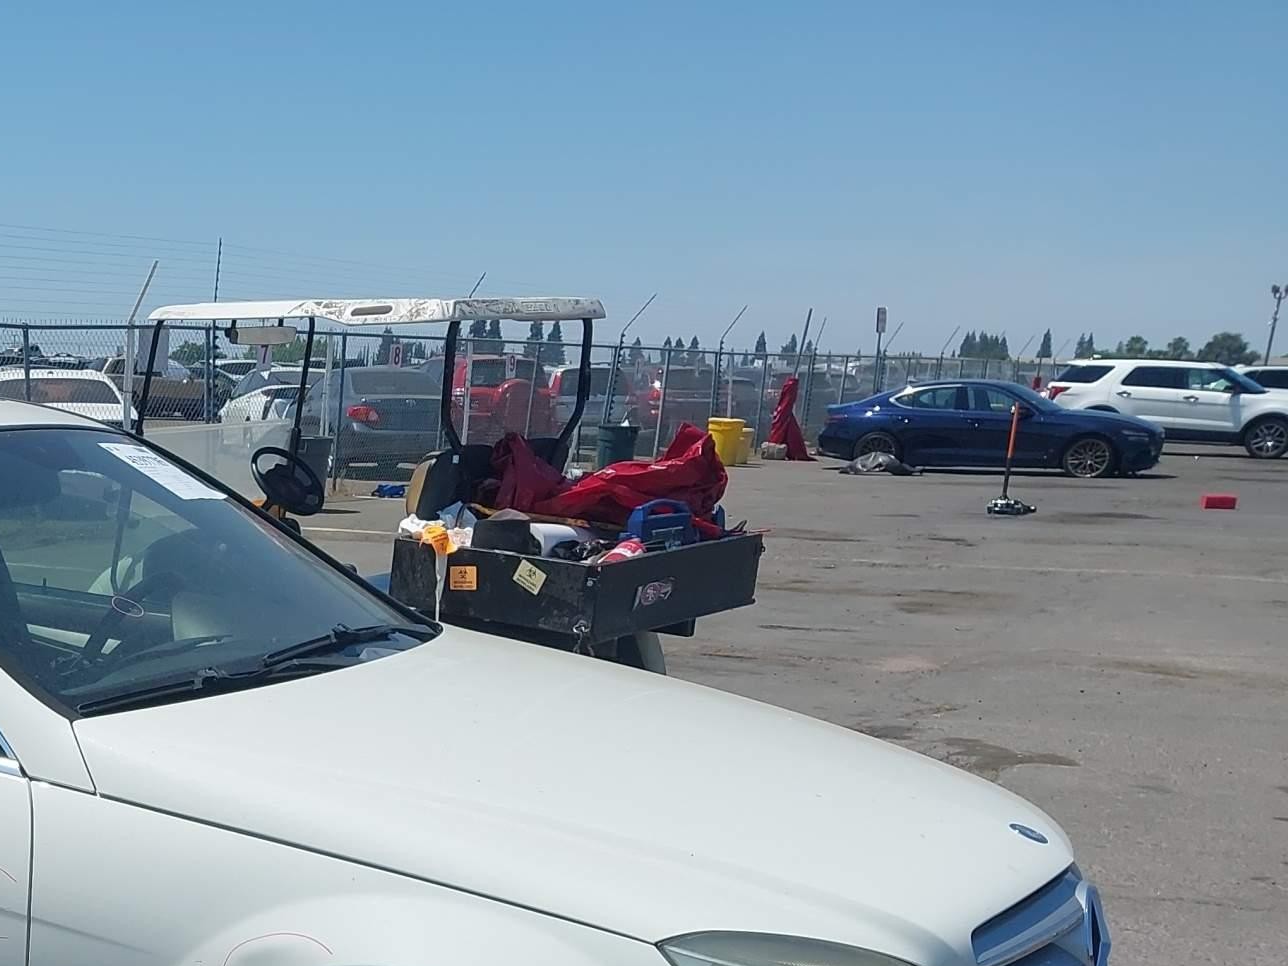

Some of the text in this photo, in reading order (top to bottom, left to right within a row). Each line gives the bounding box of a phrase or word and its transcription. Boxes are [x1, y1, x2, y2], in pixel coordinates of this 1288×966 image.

[261, 344, 269, 364] 7
[394, 346, 401, 366] 8
[509, 355, 516, 373] 9
